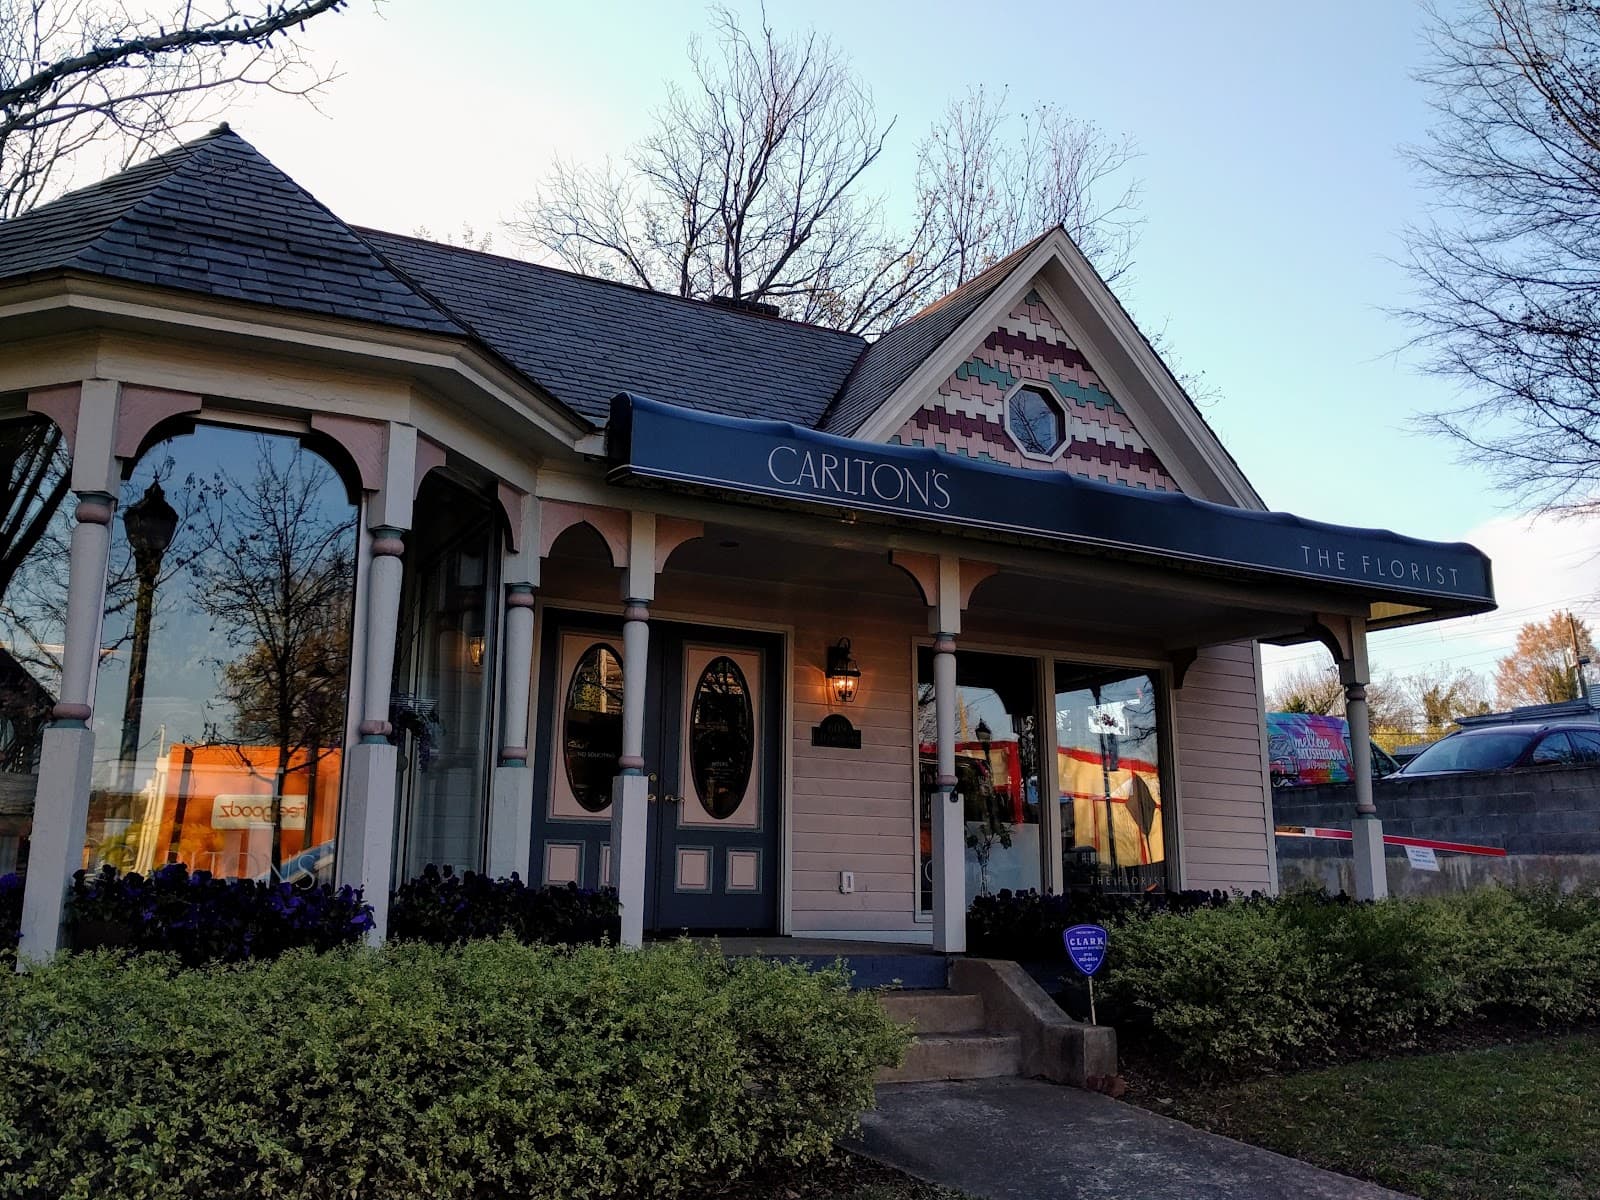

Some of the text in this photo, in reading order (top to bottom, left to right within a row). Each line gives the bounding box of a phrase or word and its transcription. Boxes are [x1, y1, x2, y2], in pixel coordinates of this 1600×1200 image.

[767, 446, 951, 509] CARLTON'S
[1300, 545, 1458, 587] THE FLORIST
[1296, 748, 1346, 761] MUSHROOM
[1089, 876, 1111, 886] THE
[1069, 937, 1104, 946] CLARK
